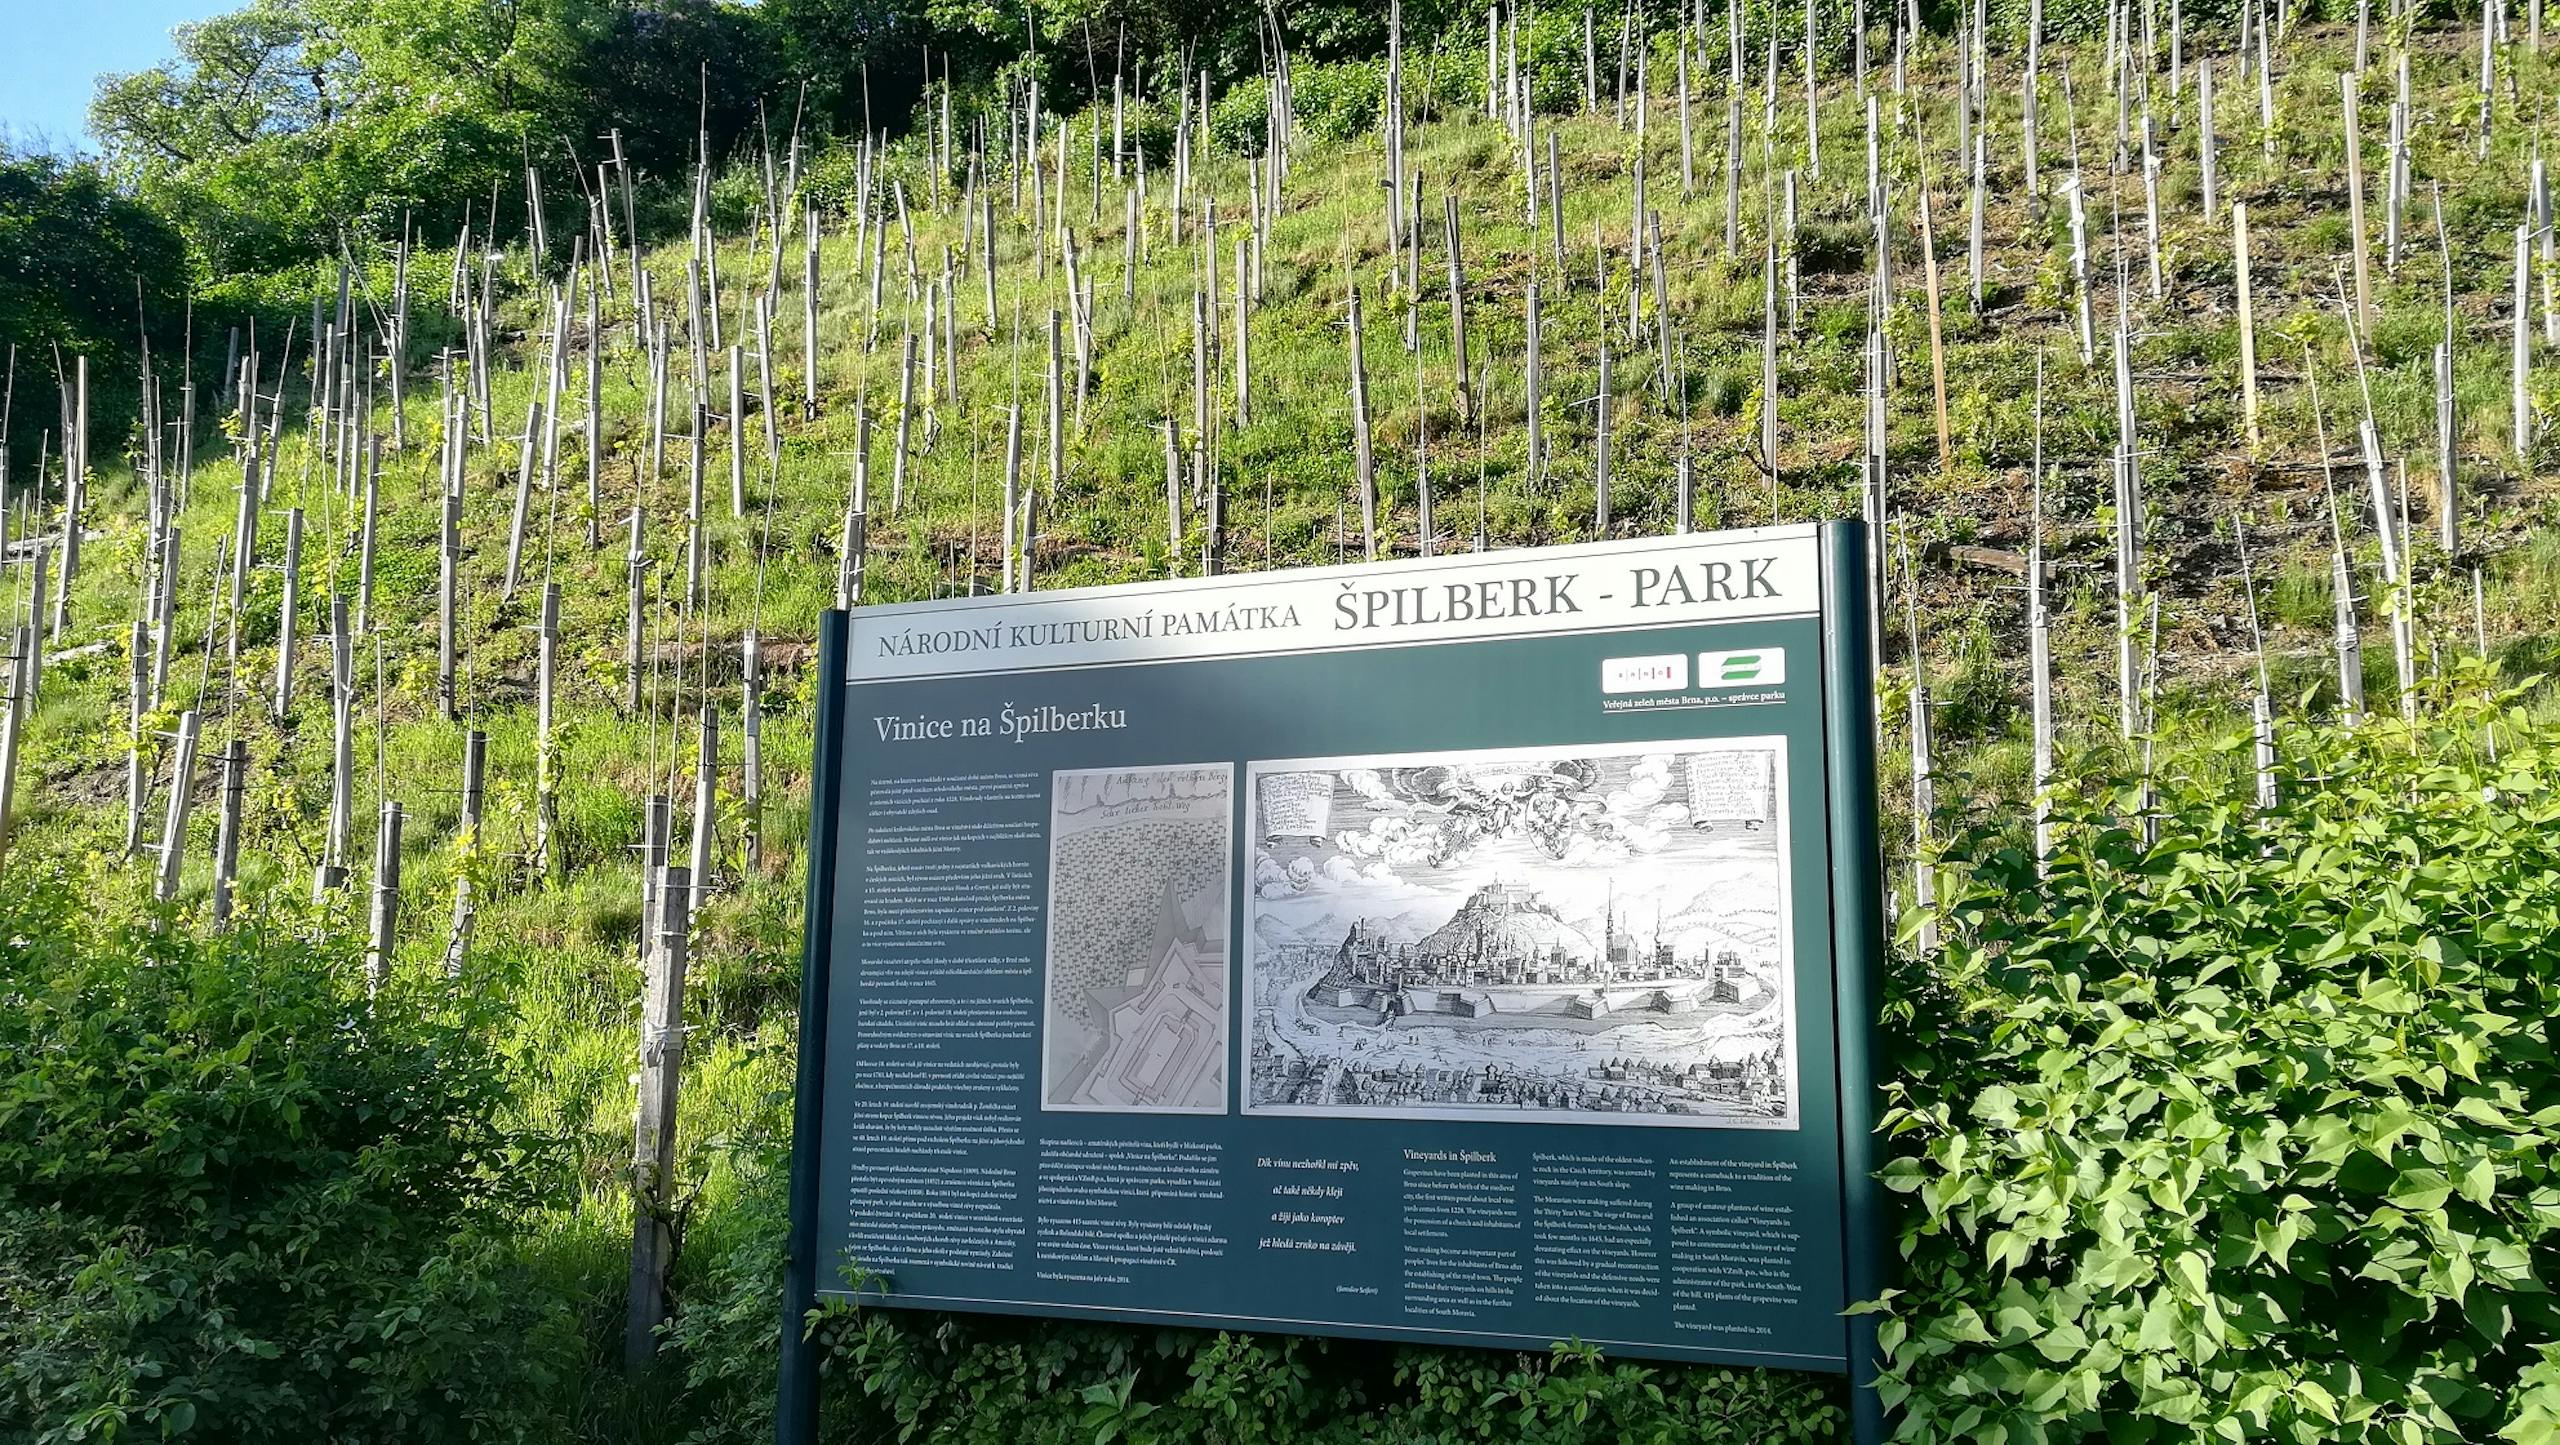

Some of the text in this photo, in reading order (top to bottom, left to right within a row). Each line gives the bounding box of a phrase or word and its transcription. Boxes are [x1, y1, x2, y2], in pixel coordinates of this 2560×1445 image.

[877, 621, 1001, 657] NÁRODNÍ
[1009, 610, 1153, 648] KULTURNÍ
[1161, 602, 1302, 636] PAMÁTKA
[1334, 580, 1582, 631] ŠPILBERK
[1629, 556, 1783, 608] PARK
[1603, 699, 1632, 710] Veřejná
[1634, 698, 1655, 708] zeleň
[1656, 697, 1680, 706] města
[1682, 696, 1703, 705] Brna,
[1705, 696, 1720, 705] p.o.
[1729, 692, 1759, 702] správce
[1761, 691, 1785, 701] parku
[874, 701, 1127, 743] Vinice na Špilberku
[1257, 1158, 1270, 1168] Dík
[1273, 1159, 1291, 1168] vínu
[1403, 1149, 1496, 1165] Vineyards in Špilberk
[1284, 1185, 1300, 1195] také
[1291, 1212, 1309, 1225] jako
[1311, 1213, 1345, 1227] koroptev
[1258, 1238, 1270, 1250] jež
[1272, 1238, 1293, 1248] hledá
[1295, 1239, 1317, 1249] zrnko
